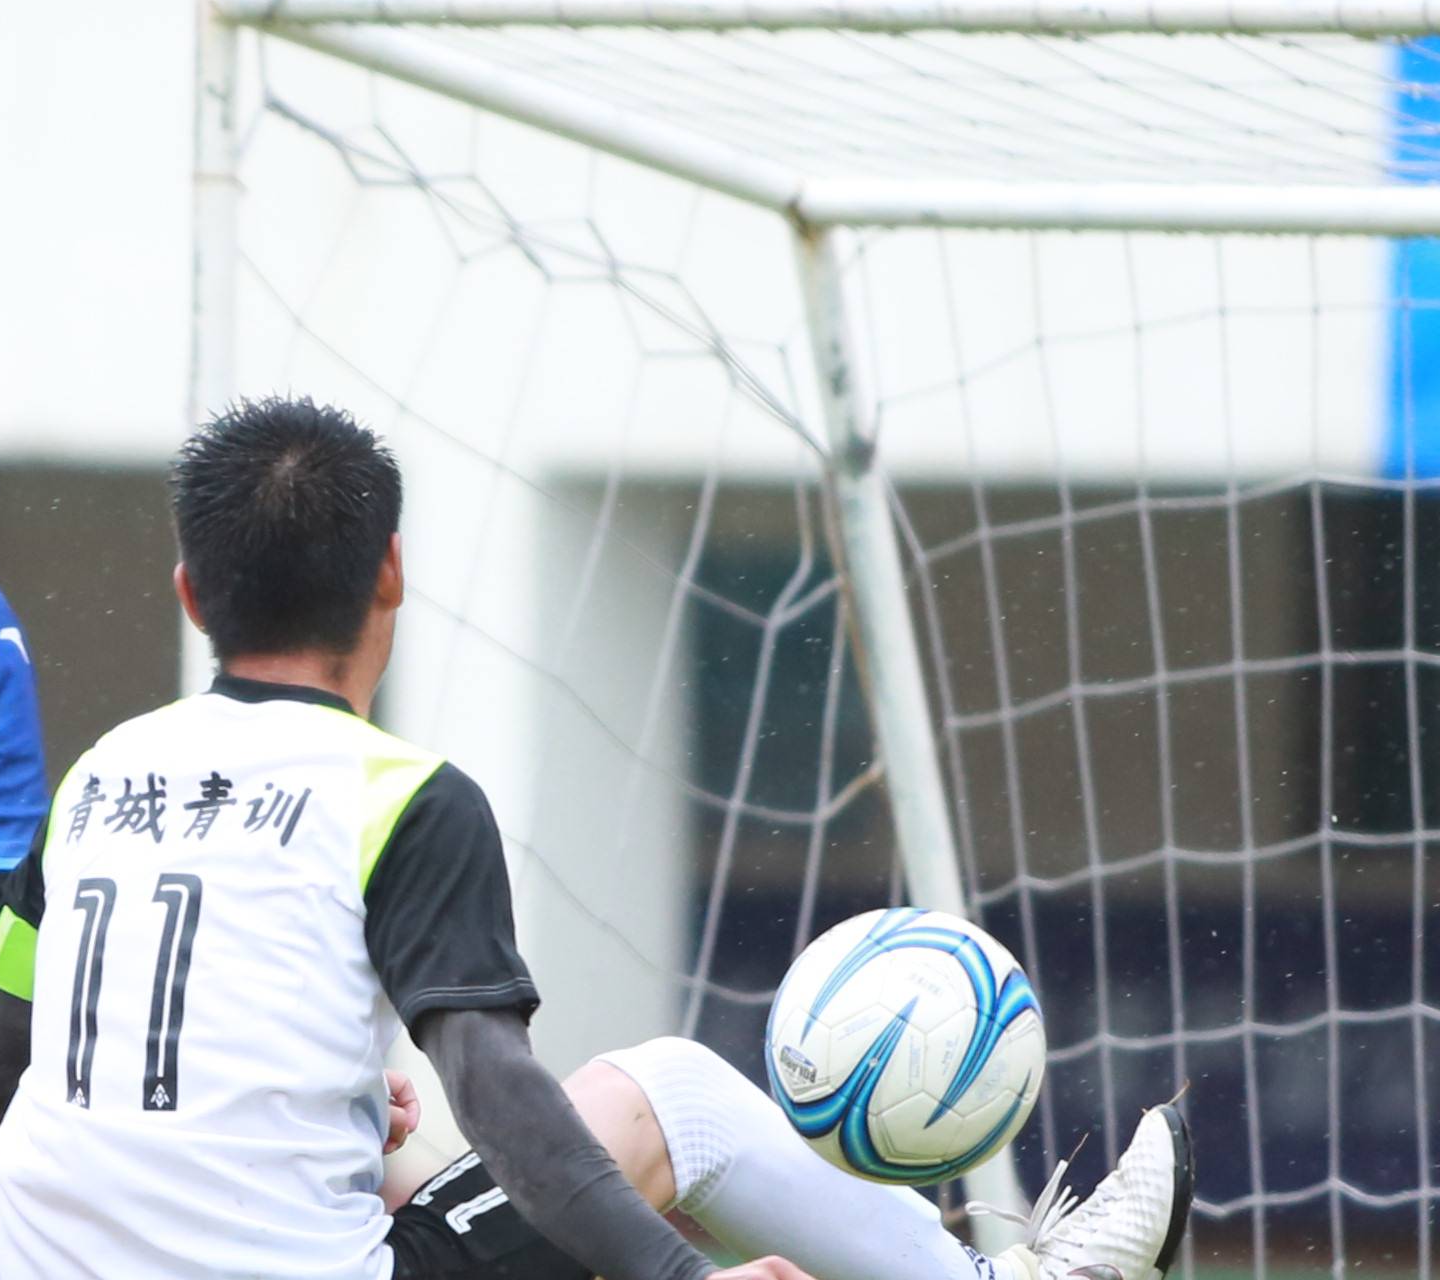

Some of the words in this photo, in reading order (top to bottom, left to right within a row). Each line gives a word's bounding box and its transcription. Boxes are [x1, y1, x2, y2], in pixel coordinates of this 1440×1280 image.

[66, 771, 313, 847] 青城青训
[66, 872, 204, 1112] 11
